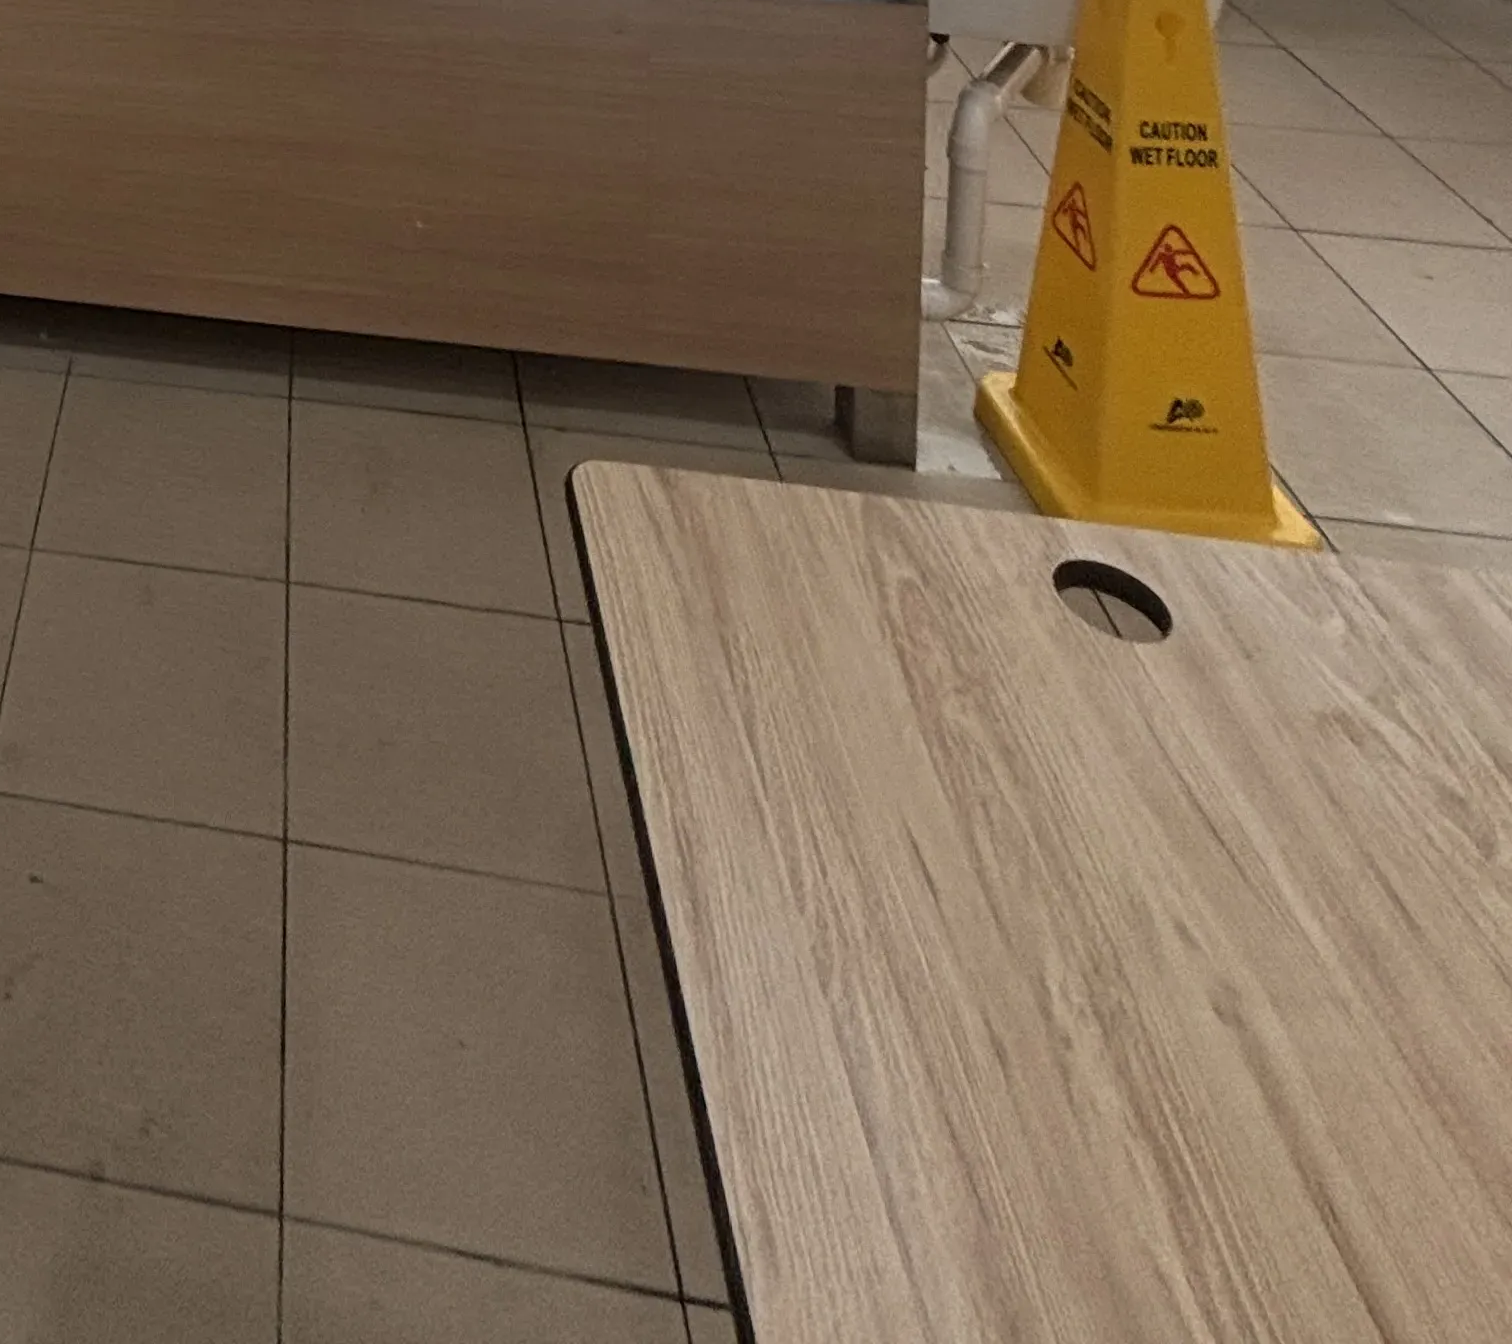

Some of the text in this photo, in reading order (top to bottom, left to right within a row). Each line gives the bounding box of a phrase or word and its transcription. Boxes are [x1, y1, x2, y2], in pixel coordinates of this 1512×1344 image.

[1139, 120, 1208, 141] CAUTION
[1129, 146, 1219, 169] WET FLOOR
